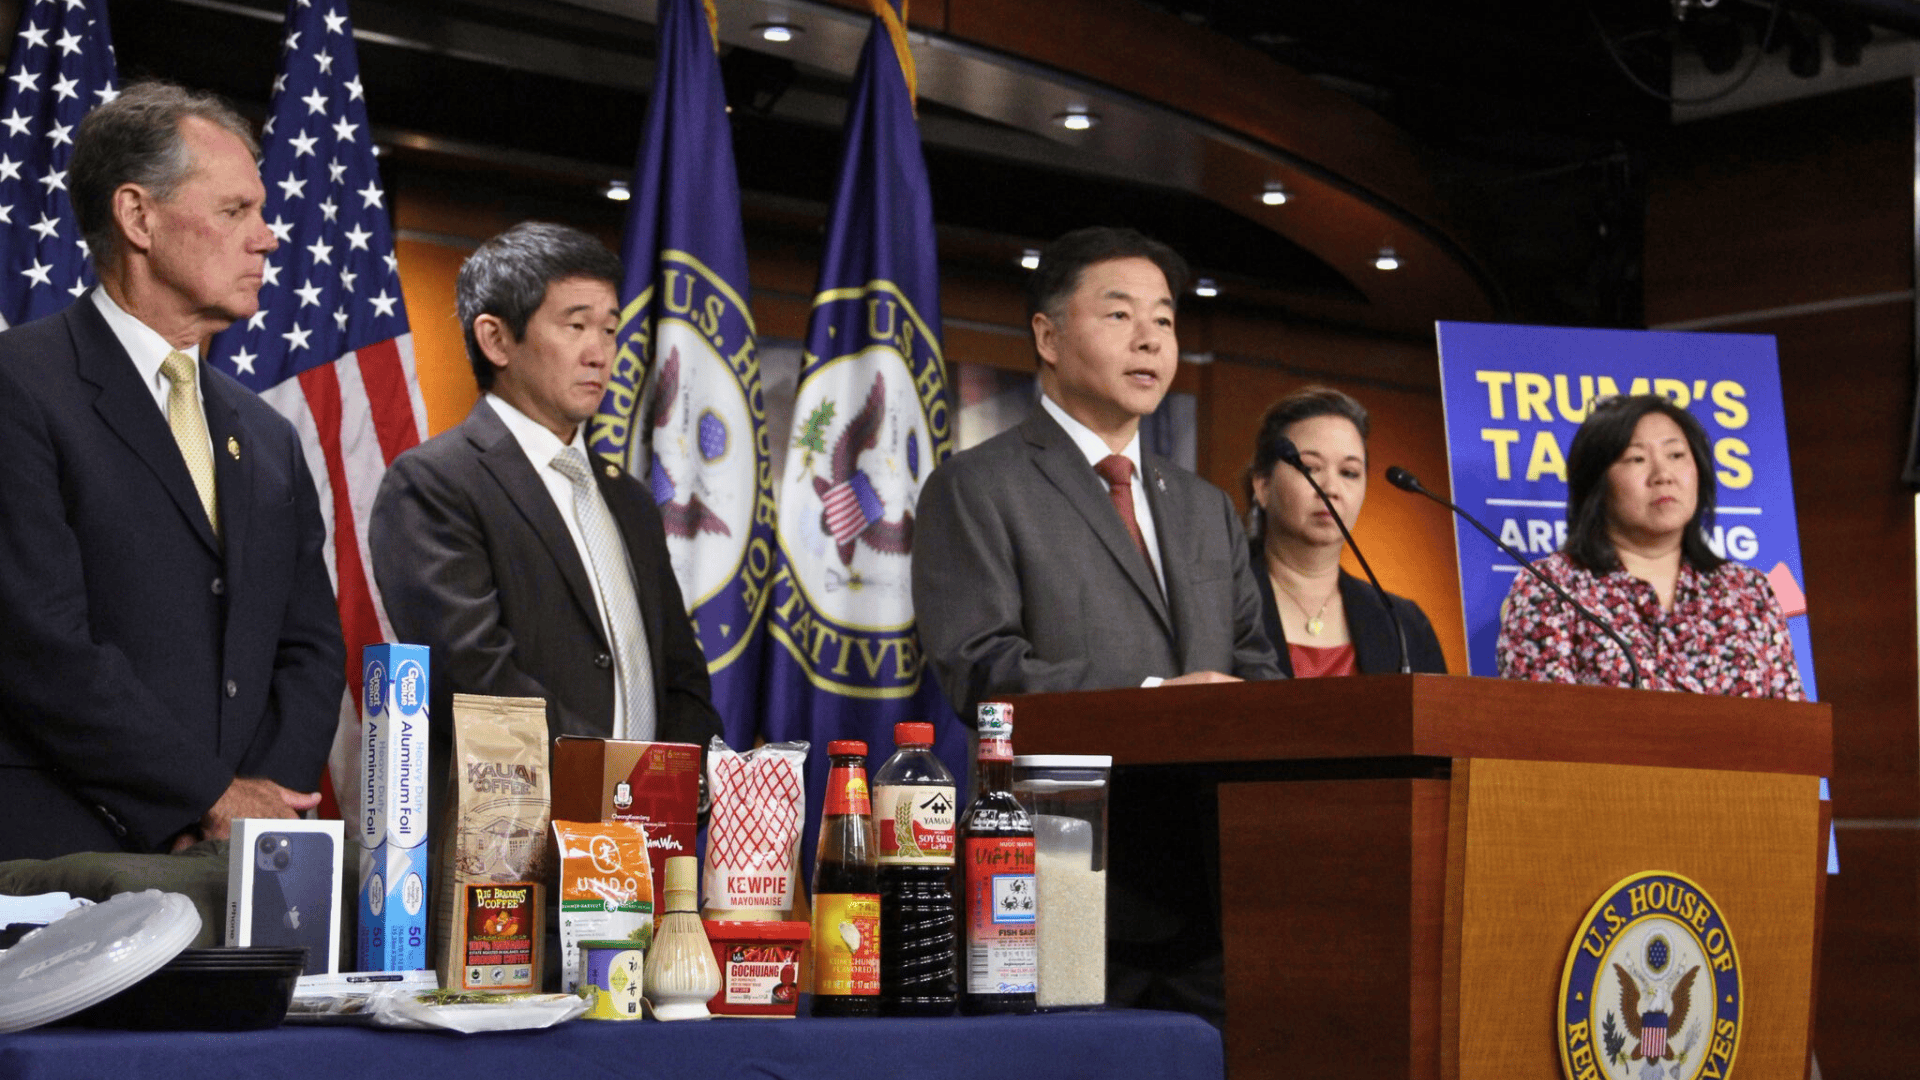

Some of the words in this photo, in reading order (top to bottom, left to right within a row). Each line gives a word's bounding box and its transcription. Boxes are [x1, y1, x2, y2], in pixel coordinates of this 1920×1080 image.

[663, 269, 726, 348] U.S.
[728, 334, 776, 531] HOUSE
[740, 536, 771, 614] OF
[374, 667, 382, 707] Great
[408, 667, 419, 707] Great
[367, 722, 377, 805] Aluminum
[378, 741, 386, 781] Heavy
[400, 720, 413, 804] Aluminum
[414, 741, 424, 782] Heavy
[413, 785, 424, 814] Duty
[473, 779, 532, 796] COFFEE
[367, 808, 376, 835] Foil
[399, 808, 412, 834] Foil
[918, 834, 935, 843] SOY
[577, 876, 638, 892] UDO
[727, 876, 787, 894] KEWPIE
[484, 898, 519, 909] COFFEE
[730, 896, 782, 906] MAYONNAISE
[372, 926, 383, 948] 50
[408, 926, 421, 947] 50
[998, 929, 1018, 937] FISH
[1582, 904, 1627, 958] U.S.
[1627, 881, 1711, 933] HOUSE
[1705, 926, 1734, 973] OF
[731, 964, 779, 977] GOCHUJANG
